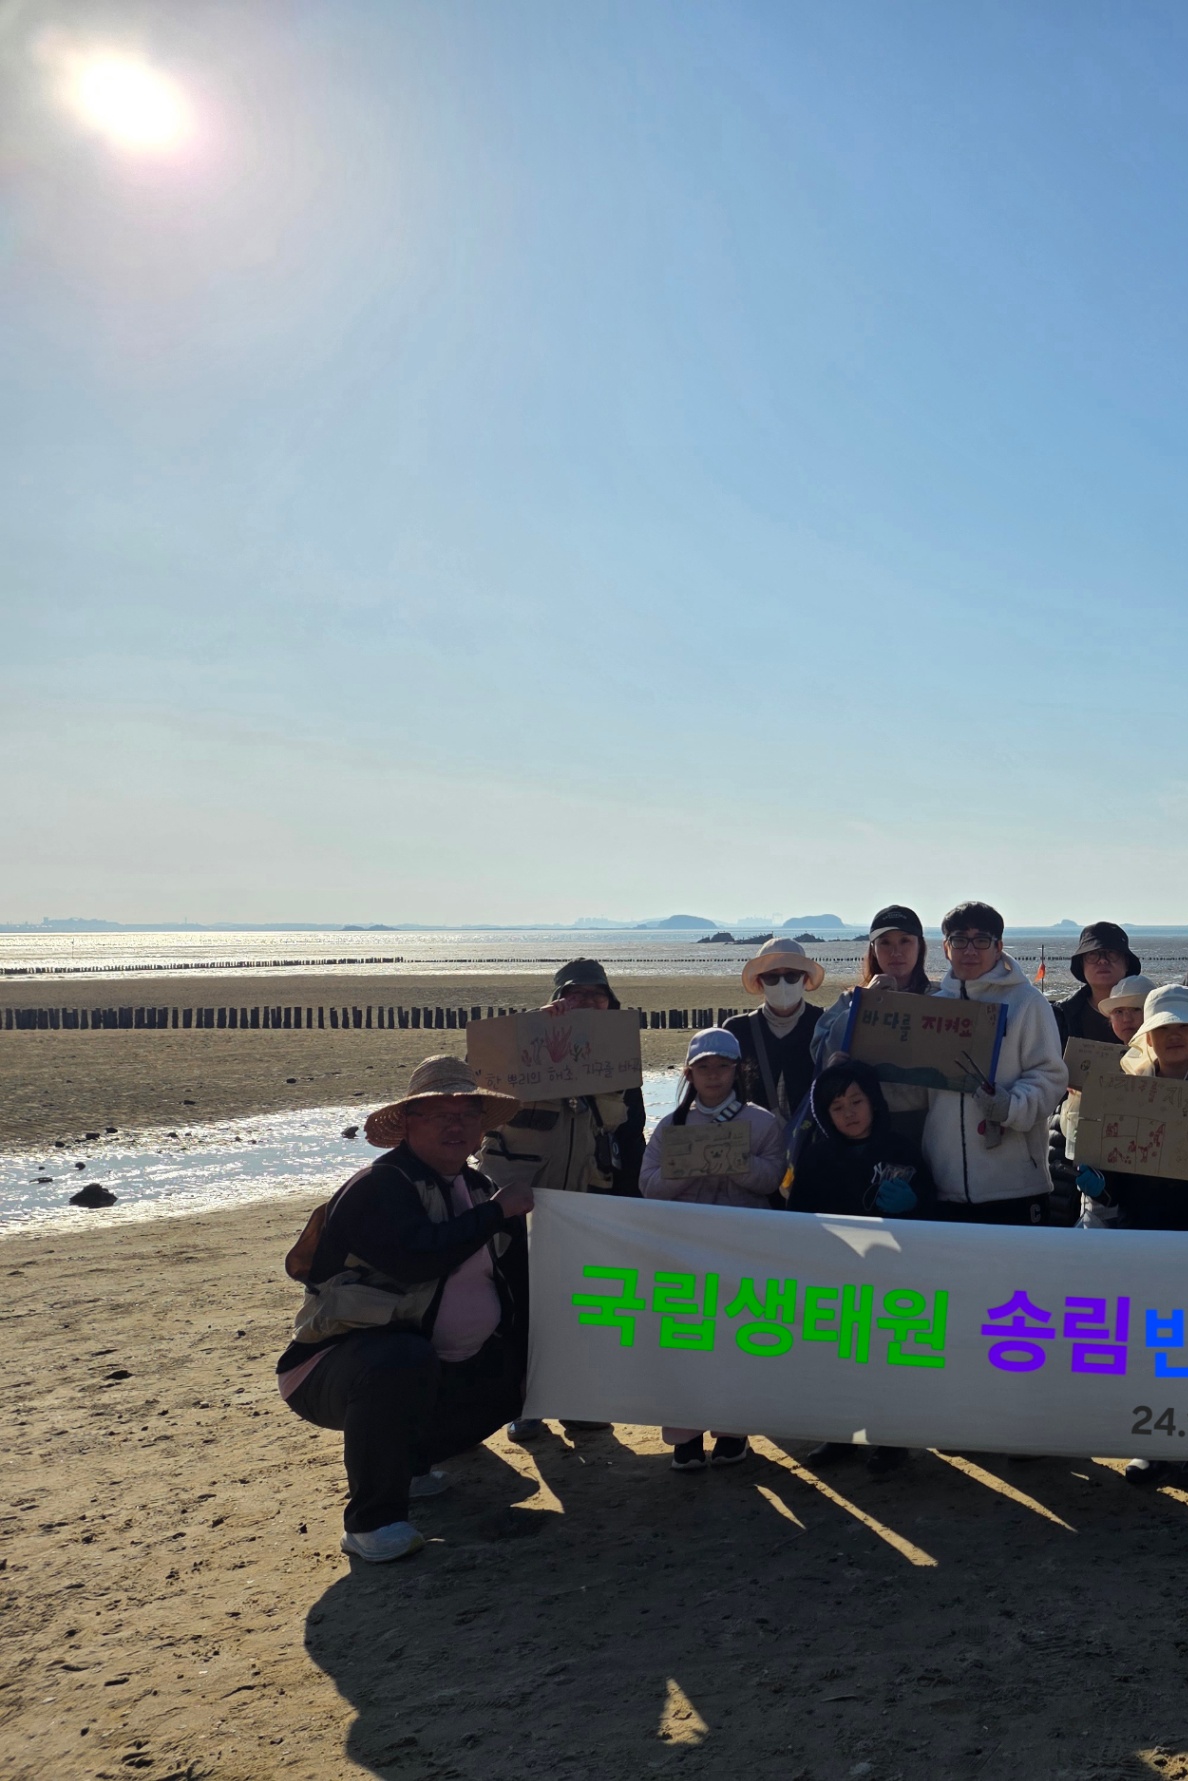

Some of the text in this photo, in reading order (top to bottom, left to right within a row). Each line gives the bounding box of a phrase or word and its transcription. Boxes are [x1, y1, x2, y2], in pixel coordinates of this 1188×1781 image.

[862, 1009, 912, 1042] 바다를
[921, 1015, 973, 1038] 지켜요
[507, 1071, 541, 1088] 뿌리의
[582, 1060, 614, 1079] 지구를
[574, 1267, 948, 1367] 국립생태원
